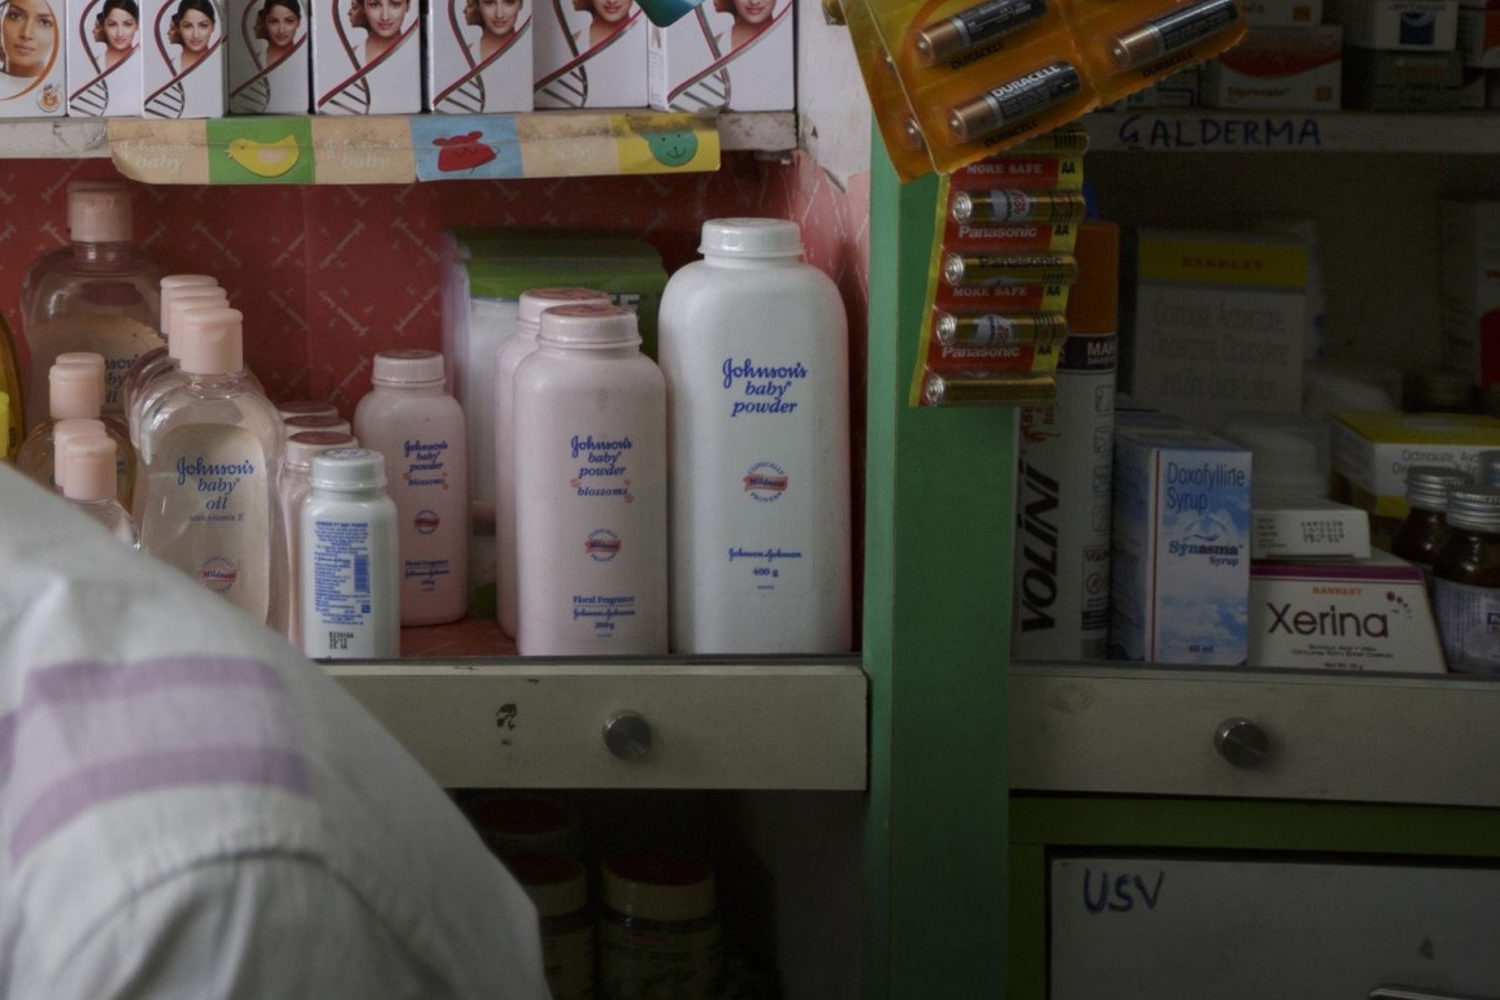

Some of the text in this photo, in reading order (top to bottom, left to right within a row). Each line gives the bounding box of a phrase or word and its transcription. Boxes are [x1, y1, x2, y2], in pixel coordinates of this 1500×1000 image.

[990, 63, 1062, 100] DURACELL
[1119, 115, 1323, 150] GALDERMA
[958, 223, 1070, 239] Panasonic AA
[722, 357, 809, 390] Johnson's
[744, 379, 793, 400] baby
[729, 398, 799, 418] powder
[403, 438, 450, 458] Johnson's
[570, 434, 633, 460] Johnson's
[587, 450, 622, 465] baby
[176, 456, 256, 486] Johnson's
[409, 460, 445, 476] powder
[578, 463, 627, 480] powder
[1166, 462, 1245, 488] Doxofylline
[197, 477, 240, 495] baby
[576, 484, 628, 498] blossoms
[205, 495, 229, 512] oil
[1166, 487, 1209, 514] Syrup
[1168, 539, 1241, 558] Synasma
[1208, 556, 1239, 568] Syrup
[1266, 602, 1390, 639] Xerina
[1083, 867, 1166, 915] USV
